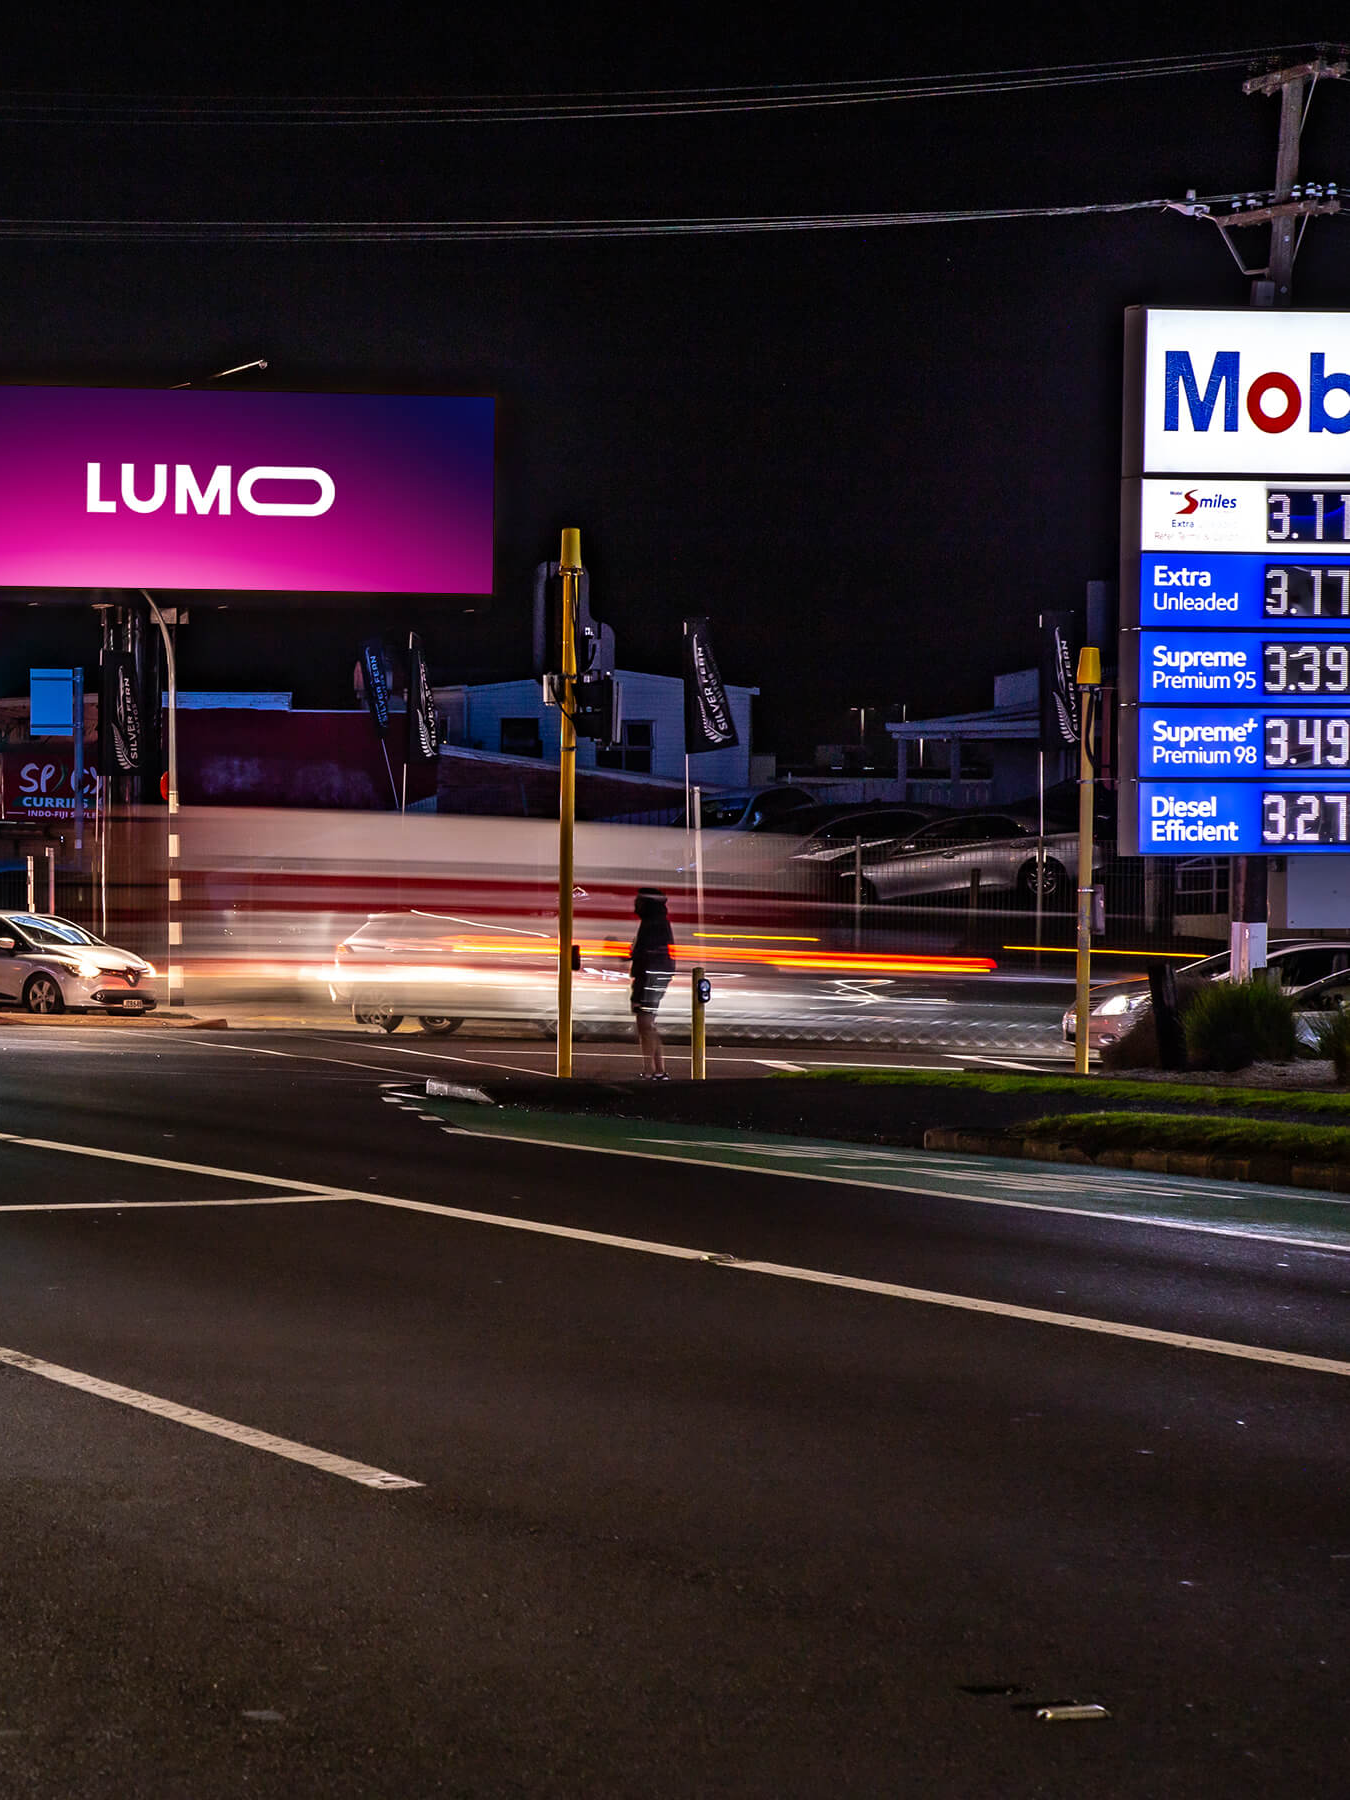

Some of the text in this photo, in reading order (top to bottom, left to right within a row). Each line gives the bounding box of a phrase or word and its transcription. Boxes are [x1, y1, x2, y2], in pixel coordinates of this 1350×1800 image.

[87, 462, 336, 517] LUMO
[1175, 489, 1238, 515] Smiles
[1171, 519, 1195, 528] Extra
[1154, 565, 1211, 587] Extra
[1153, 592, 1239, 611] Unleaded
[1266, 569, 1350, 615] 3.17
[1153, 645, 1247, 673] Supreme
[1264, 646, 1348, 691] 3.39
[1153, 671, 1257, 689] Premium 95
[704, 687, 728, 731] SILVER
[127, 715, 138, 760] SILVER
[1265, 720, 1350, 765] 3.49
[1153, 746, 1258, 764] Premium 98
[1151, 796, 1217, 818] Diesel
[1263, 795, 1347, 841] 3.27
[1151, 821, 1239, 842] Efficient
